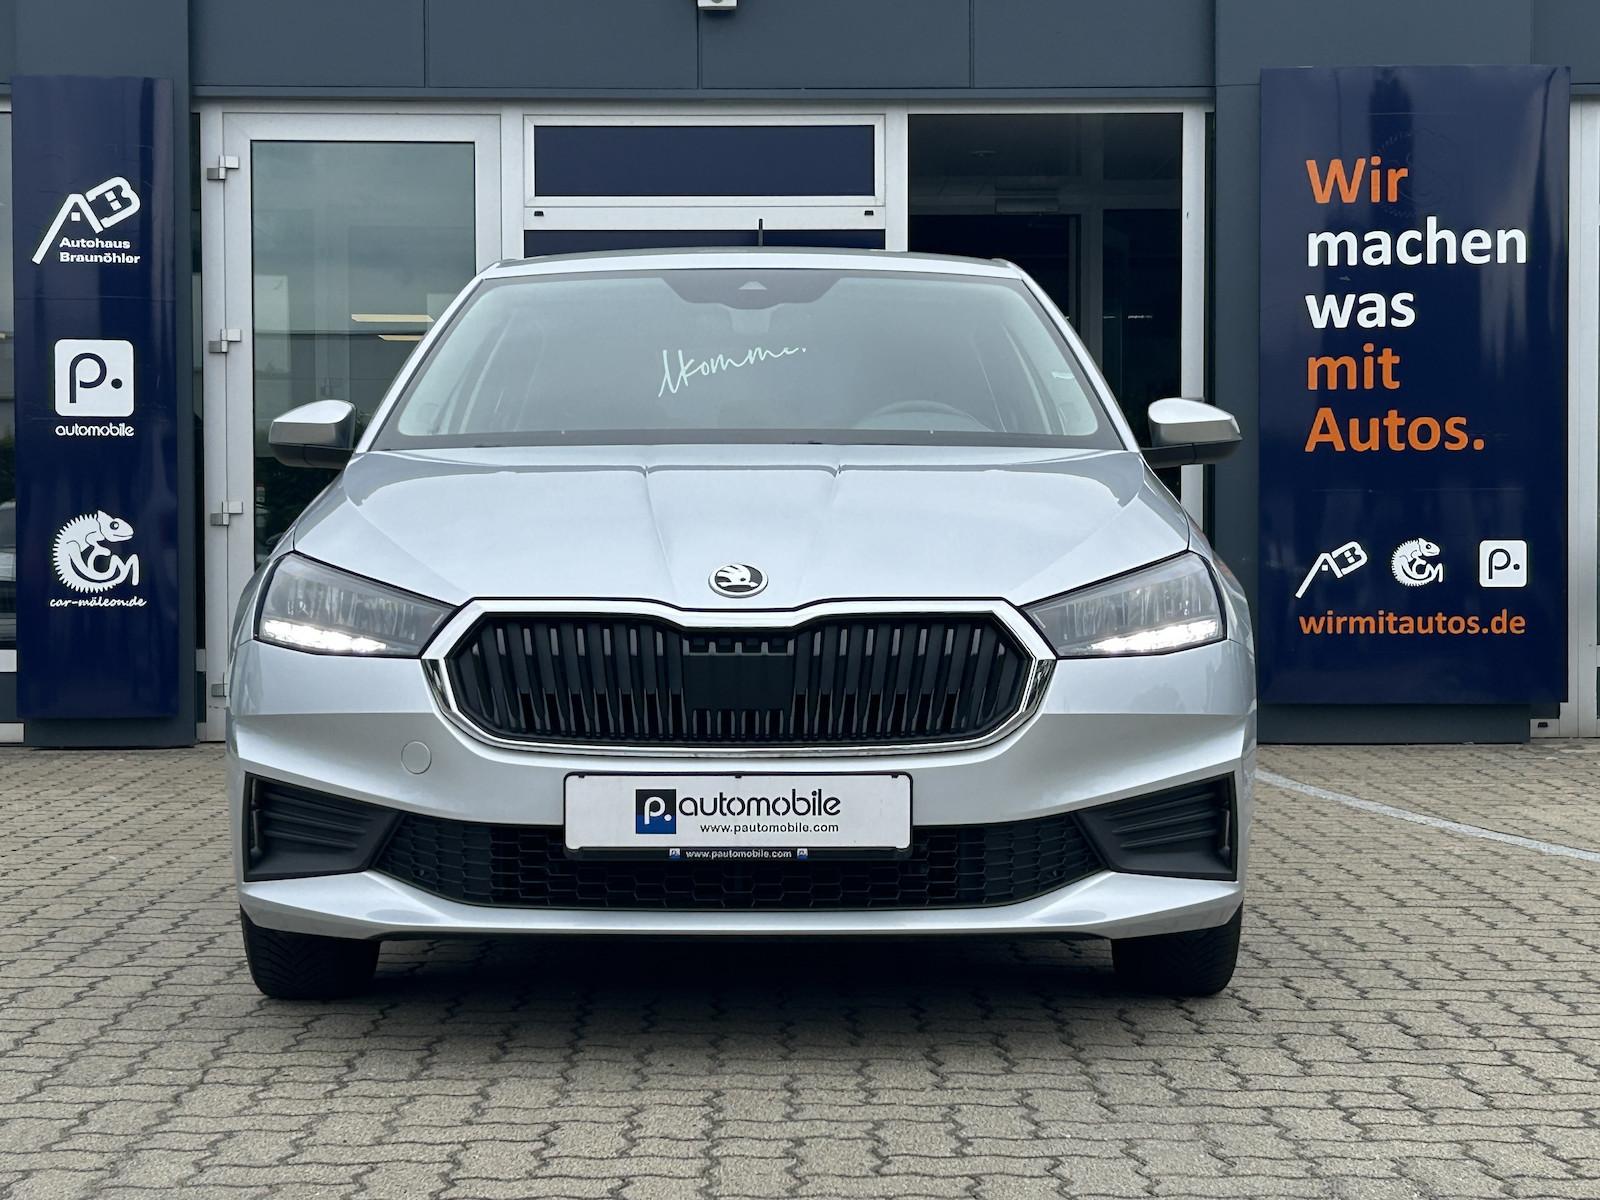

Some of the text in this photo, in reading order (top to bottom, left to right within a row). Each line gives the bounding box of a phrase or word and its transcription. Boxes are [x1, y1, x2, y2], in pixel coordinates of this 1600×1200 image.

[1305, 156, 1409, 204] Wir
[59, 237, 131, 249] Autohaus
[1307, 215, 1527, 267] machen
[59, 251, 141, 265] Braunöhler
[1305, 292, 1416, 329] was
[1307, 342, 1401, 391] mit
[55, 422, 135, 438] automobile
[1304, 407, 1486, 453] Autos.
[1298, 608, 1527, 635] wirmitautos.de
[677, 789, 842, 817] automobile
[700, 822, 840, 834] www.pautomobile.com
[685, 849, 793, 860] www.pautomobile.com
